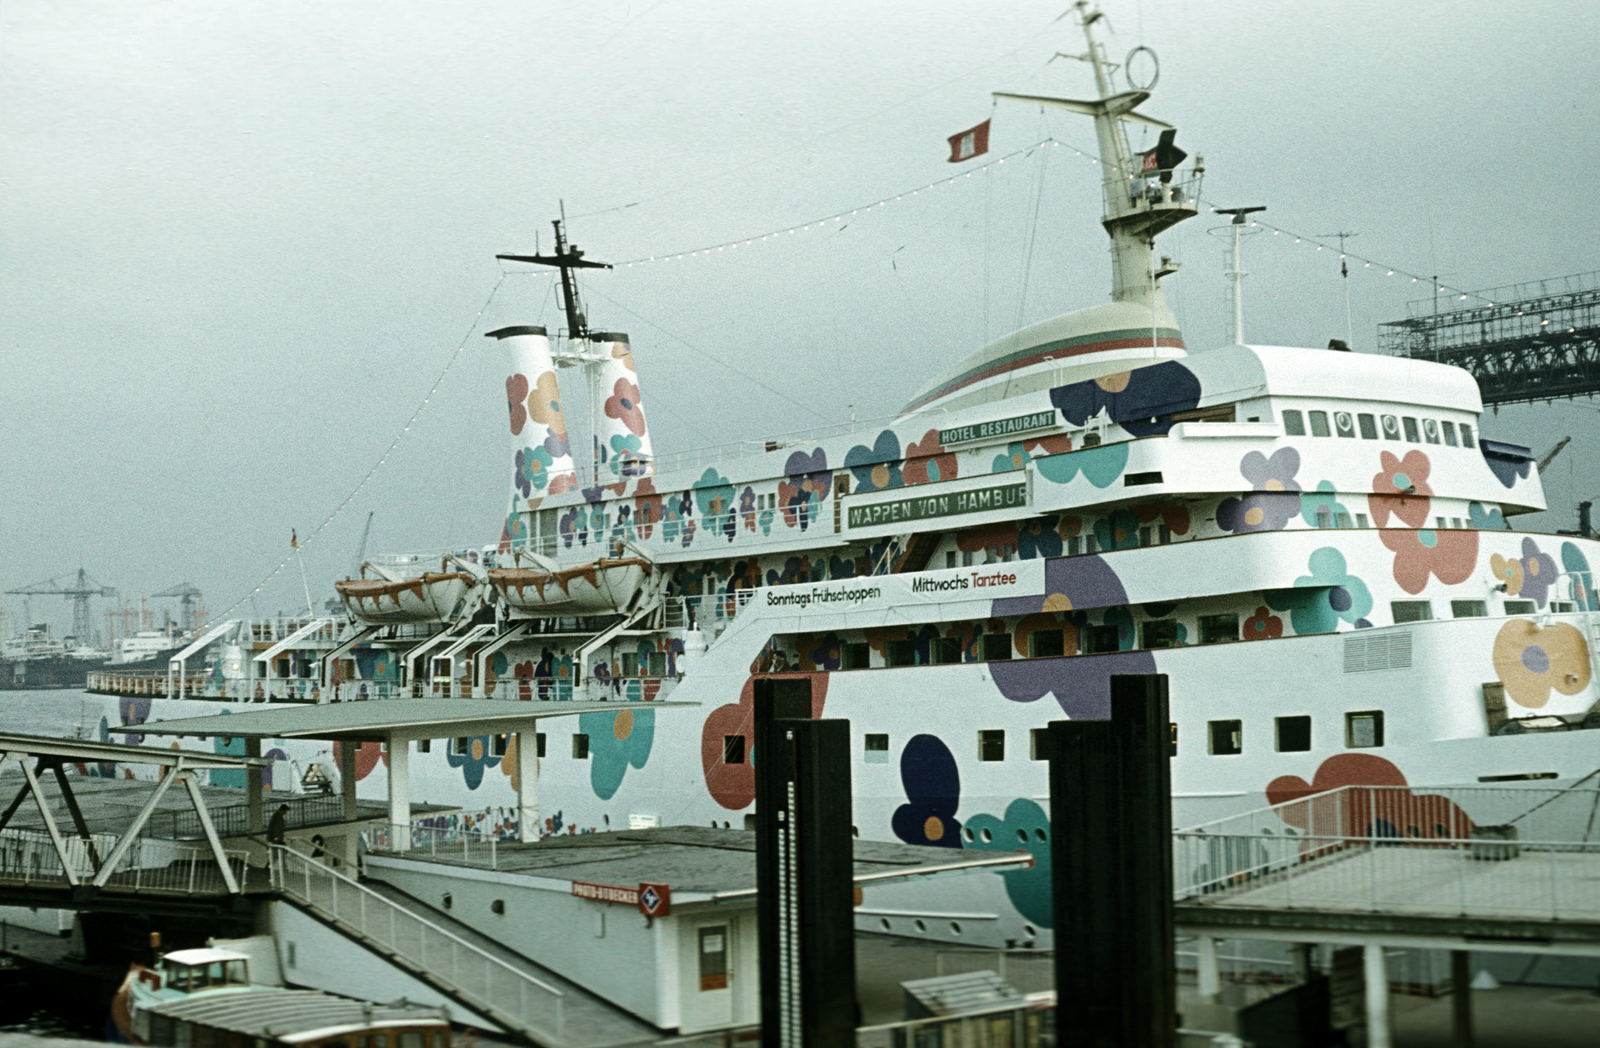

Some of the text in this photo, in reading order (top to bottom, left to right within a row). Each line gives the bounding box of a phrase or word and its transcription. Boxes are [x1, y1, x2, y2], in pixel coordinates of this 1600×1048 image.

[942, 411, 1053, 443] HOTEL RESTAURANT
[850, 487, 1026, 525] WAPPEN VON HAMBUR
[912, 571, 1017, 592] Mittwochs Tanztee
[767, 586, 881, 608] Sonntags Frühschoppen
